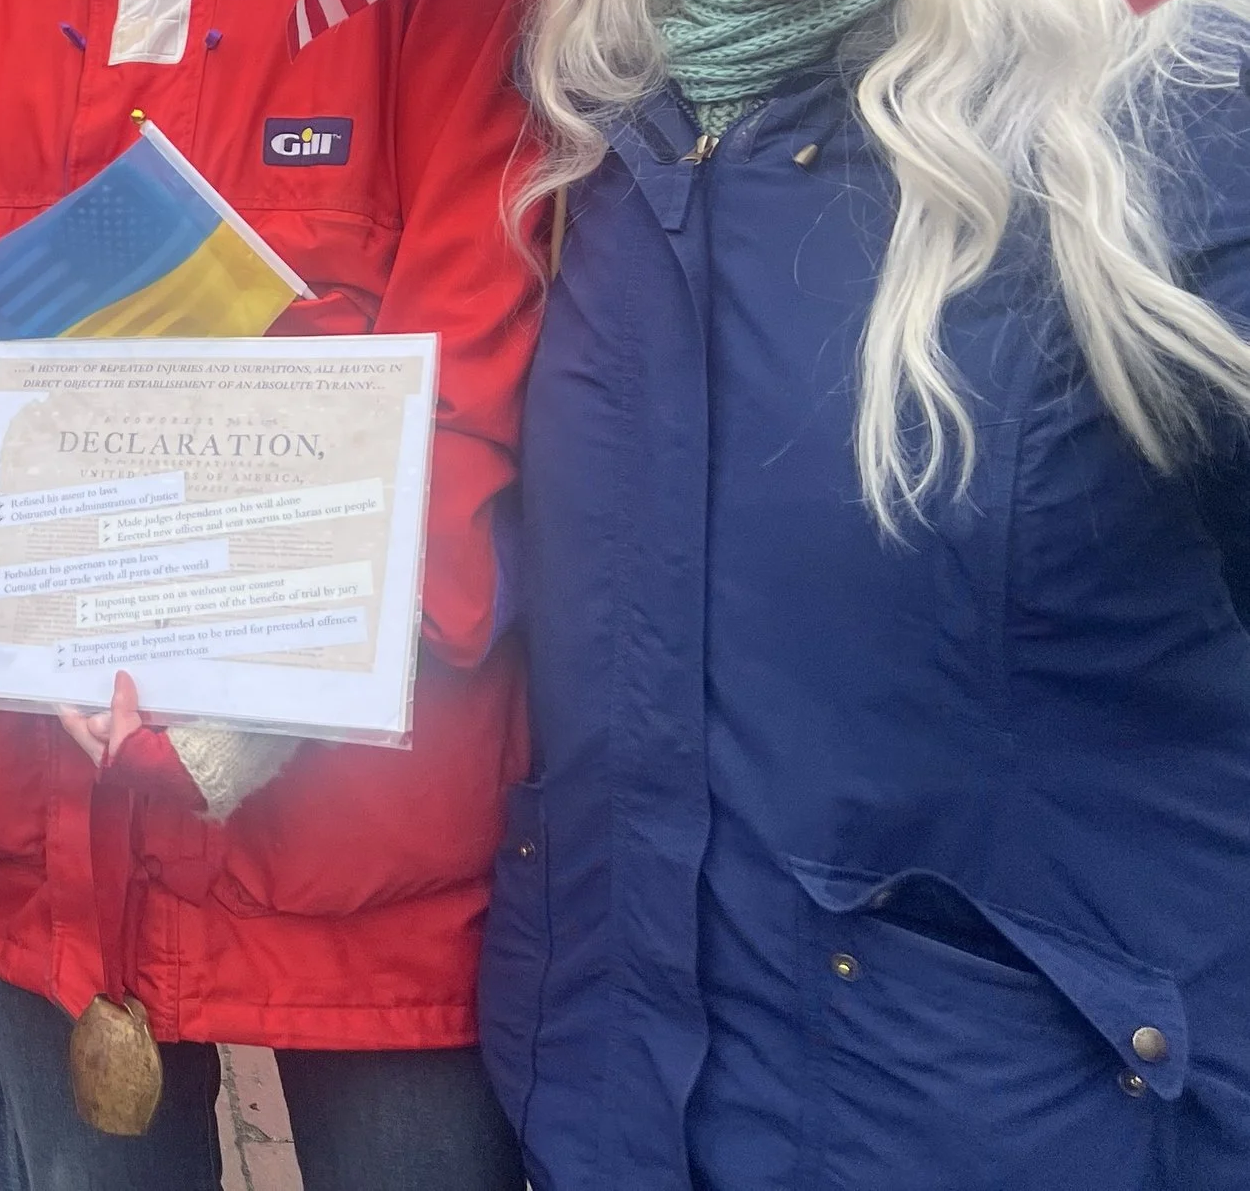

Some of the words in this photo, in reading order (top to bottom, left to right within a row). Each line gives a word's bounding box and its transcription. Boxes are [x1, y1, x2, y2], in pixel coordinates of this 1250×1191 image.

[38, 364, 80, 373] HISTORY
[83, 364, 98, 373] OF
[100, 364, 154, 373] REPEATED
[156, 364, 204, 375] INJURIES
[207, 364, 231, 374] AND
[314, 364, 336, 374] ALL
[340, 364, 386, 374] HAVING
[389, 363, 403, 373] IN
[22, 379, 62, 388] DIRECT
[64, 379, 103, 389] OBJECT
[104, 379, 125, 389] THE
[127, 379, 215, 389] ESTABLISHMENT
[218, 380, 233, 390] OF
[235, 380, 253, 390] AN
[253, 380, 313, 390] ABSOLUTE
[58, 431, 325, 460] DECLARATION,
